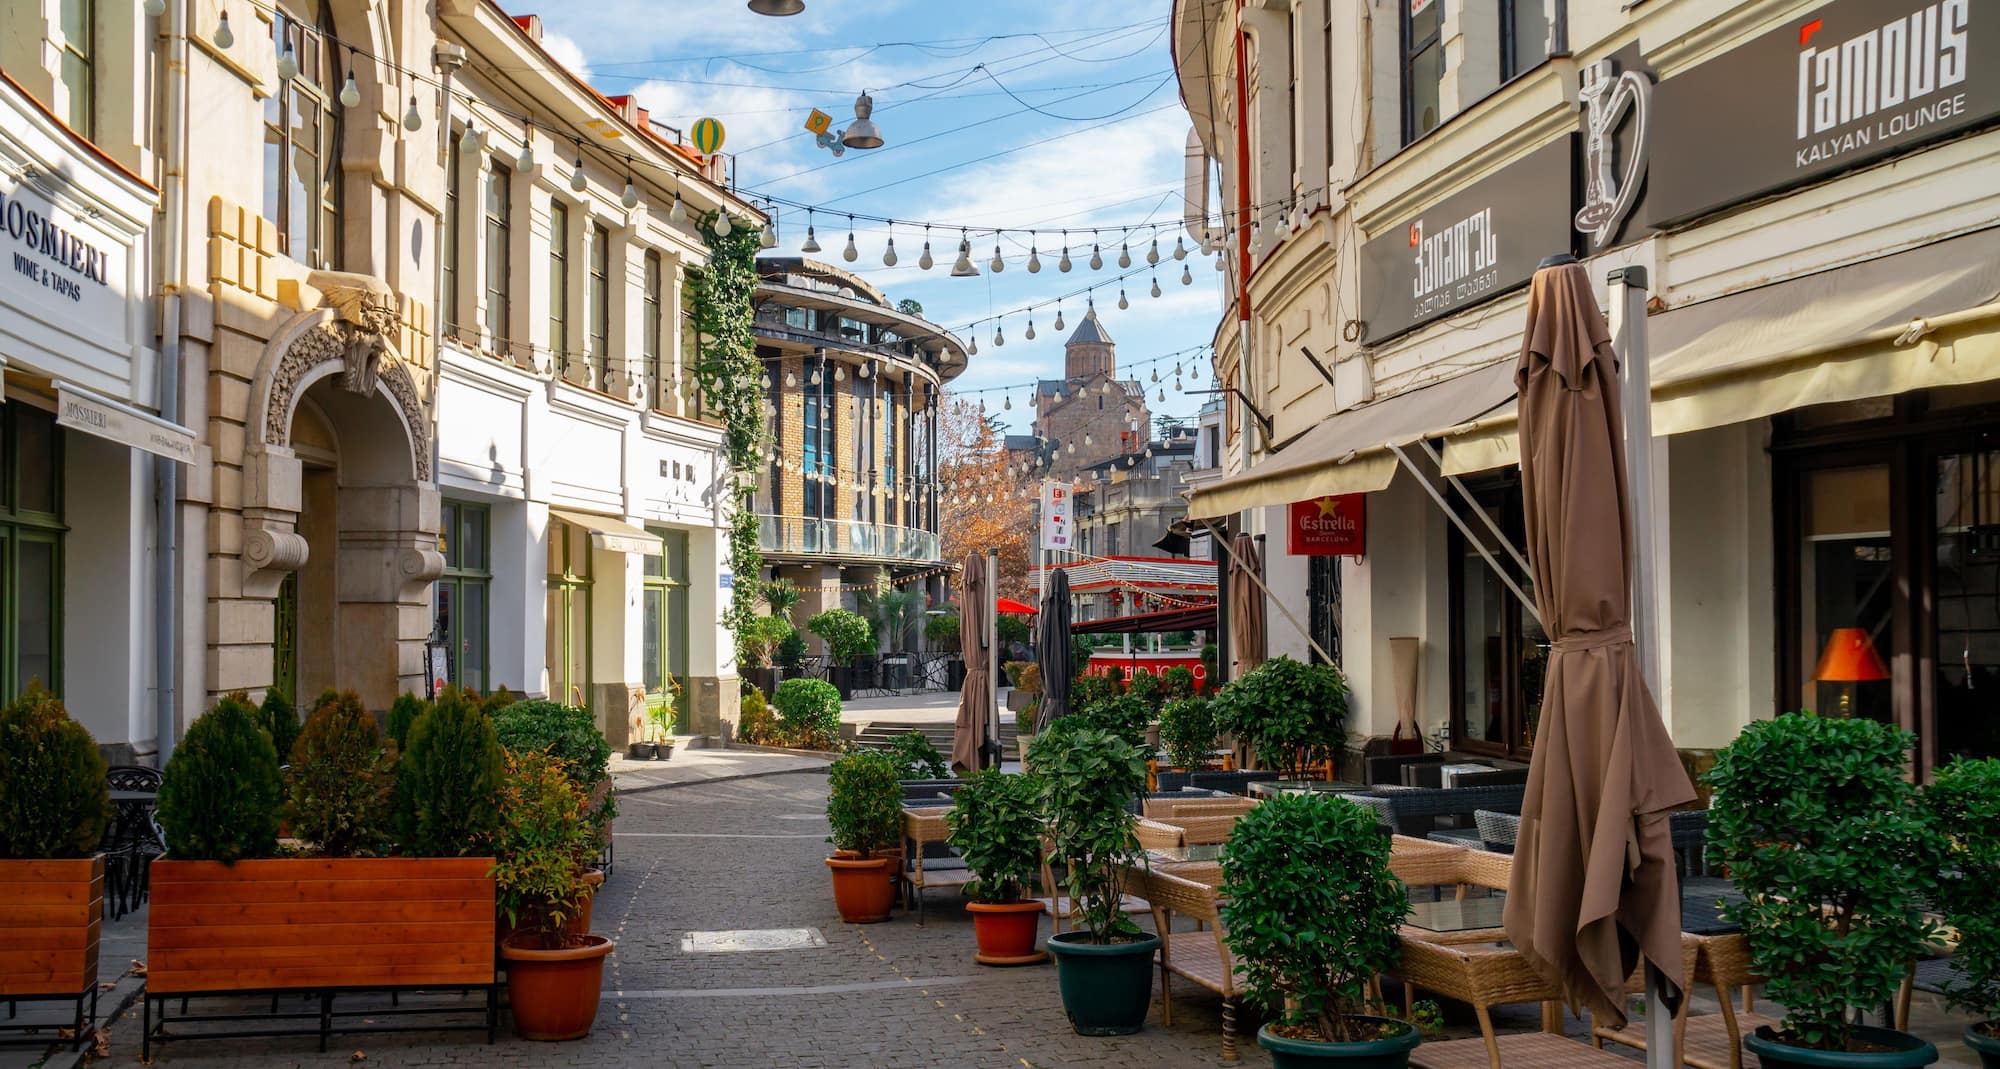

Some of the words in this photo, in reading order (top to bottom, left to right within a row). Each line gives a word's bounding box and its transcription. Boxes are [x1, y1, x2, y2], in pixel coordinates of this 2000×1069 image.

[1796, 127, 1870, 168] KALYAN
[1878, 93, 1966, 141] LOUNGE
[14, 251, 40, 282] WINE
[42, 268, 48, 287] &
[51, 271, 81, 302] TAPAS
[1300, 515, 1356, 531] Estrella
